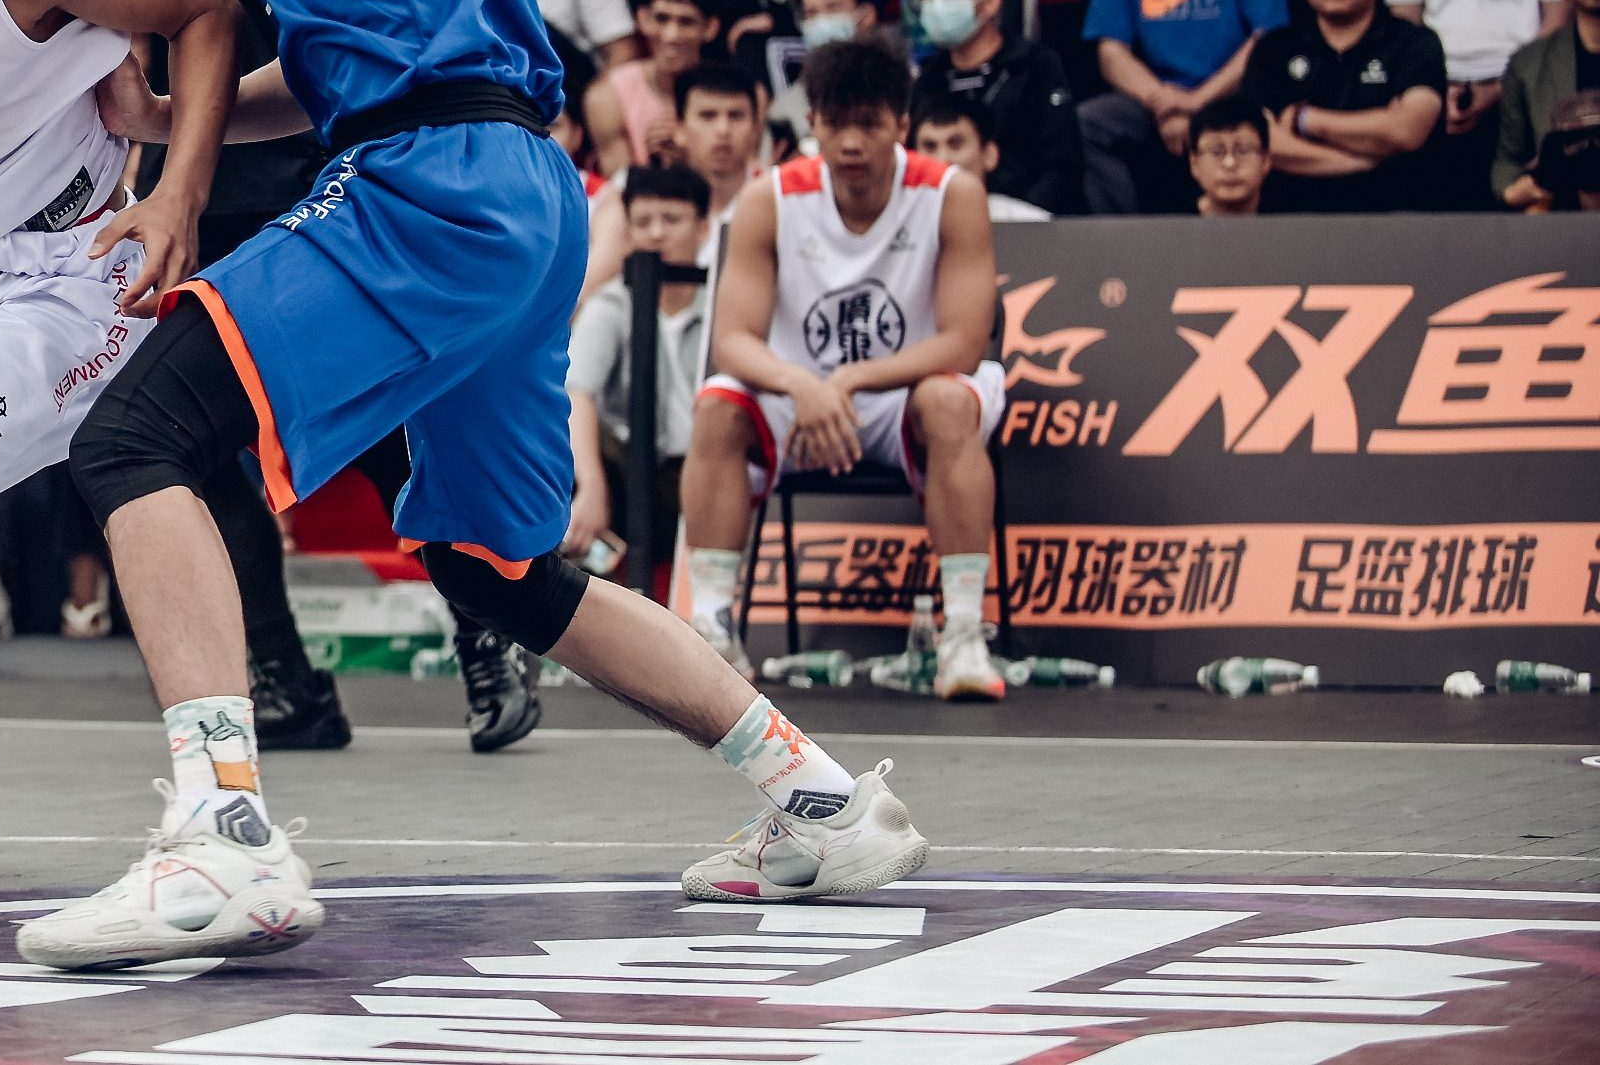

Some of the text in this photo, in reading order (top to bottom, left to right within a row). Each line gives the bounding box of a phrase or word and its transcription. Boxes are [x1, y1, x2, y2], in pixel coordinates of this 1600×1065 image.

[1001, 399, 1119, 447] FISH
[1004, 536, 1248, 615] 羽球器材
[1290, 534, 1538, 616] 足篮排球
